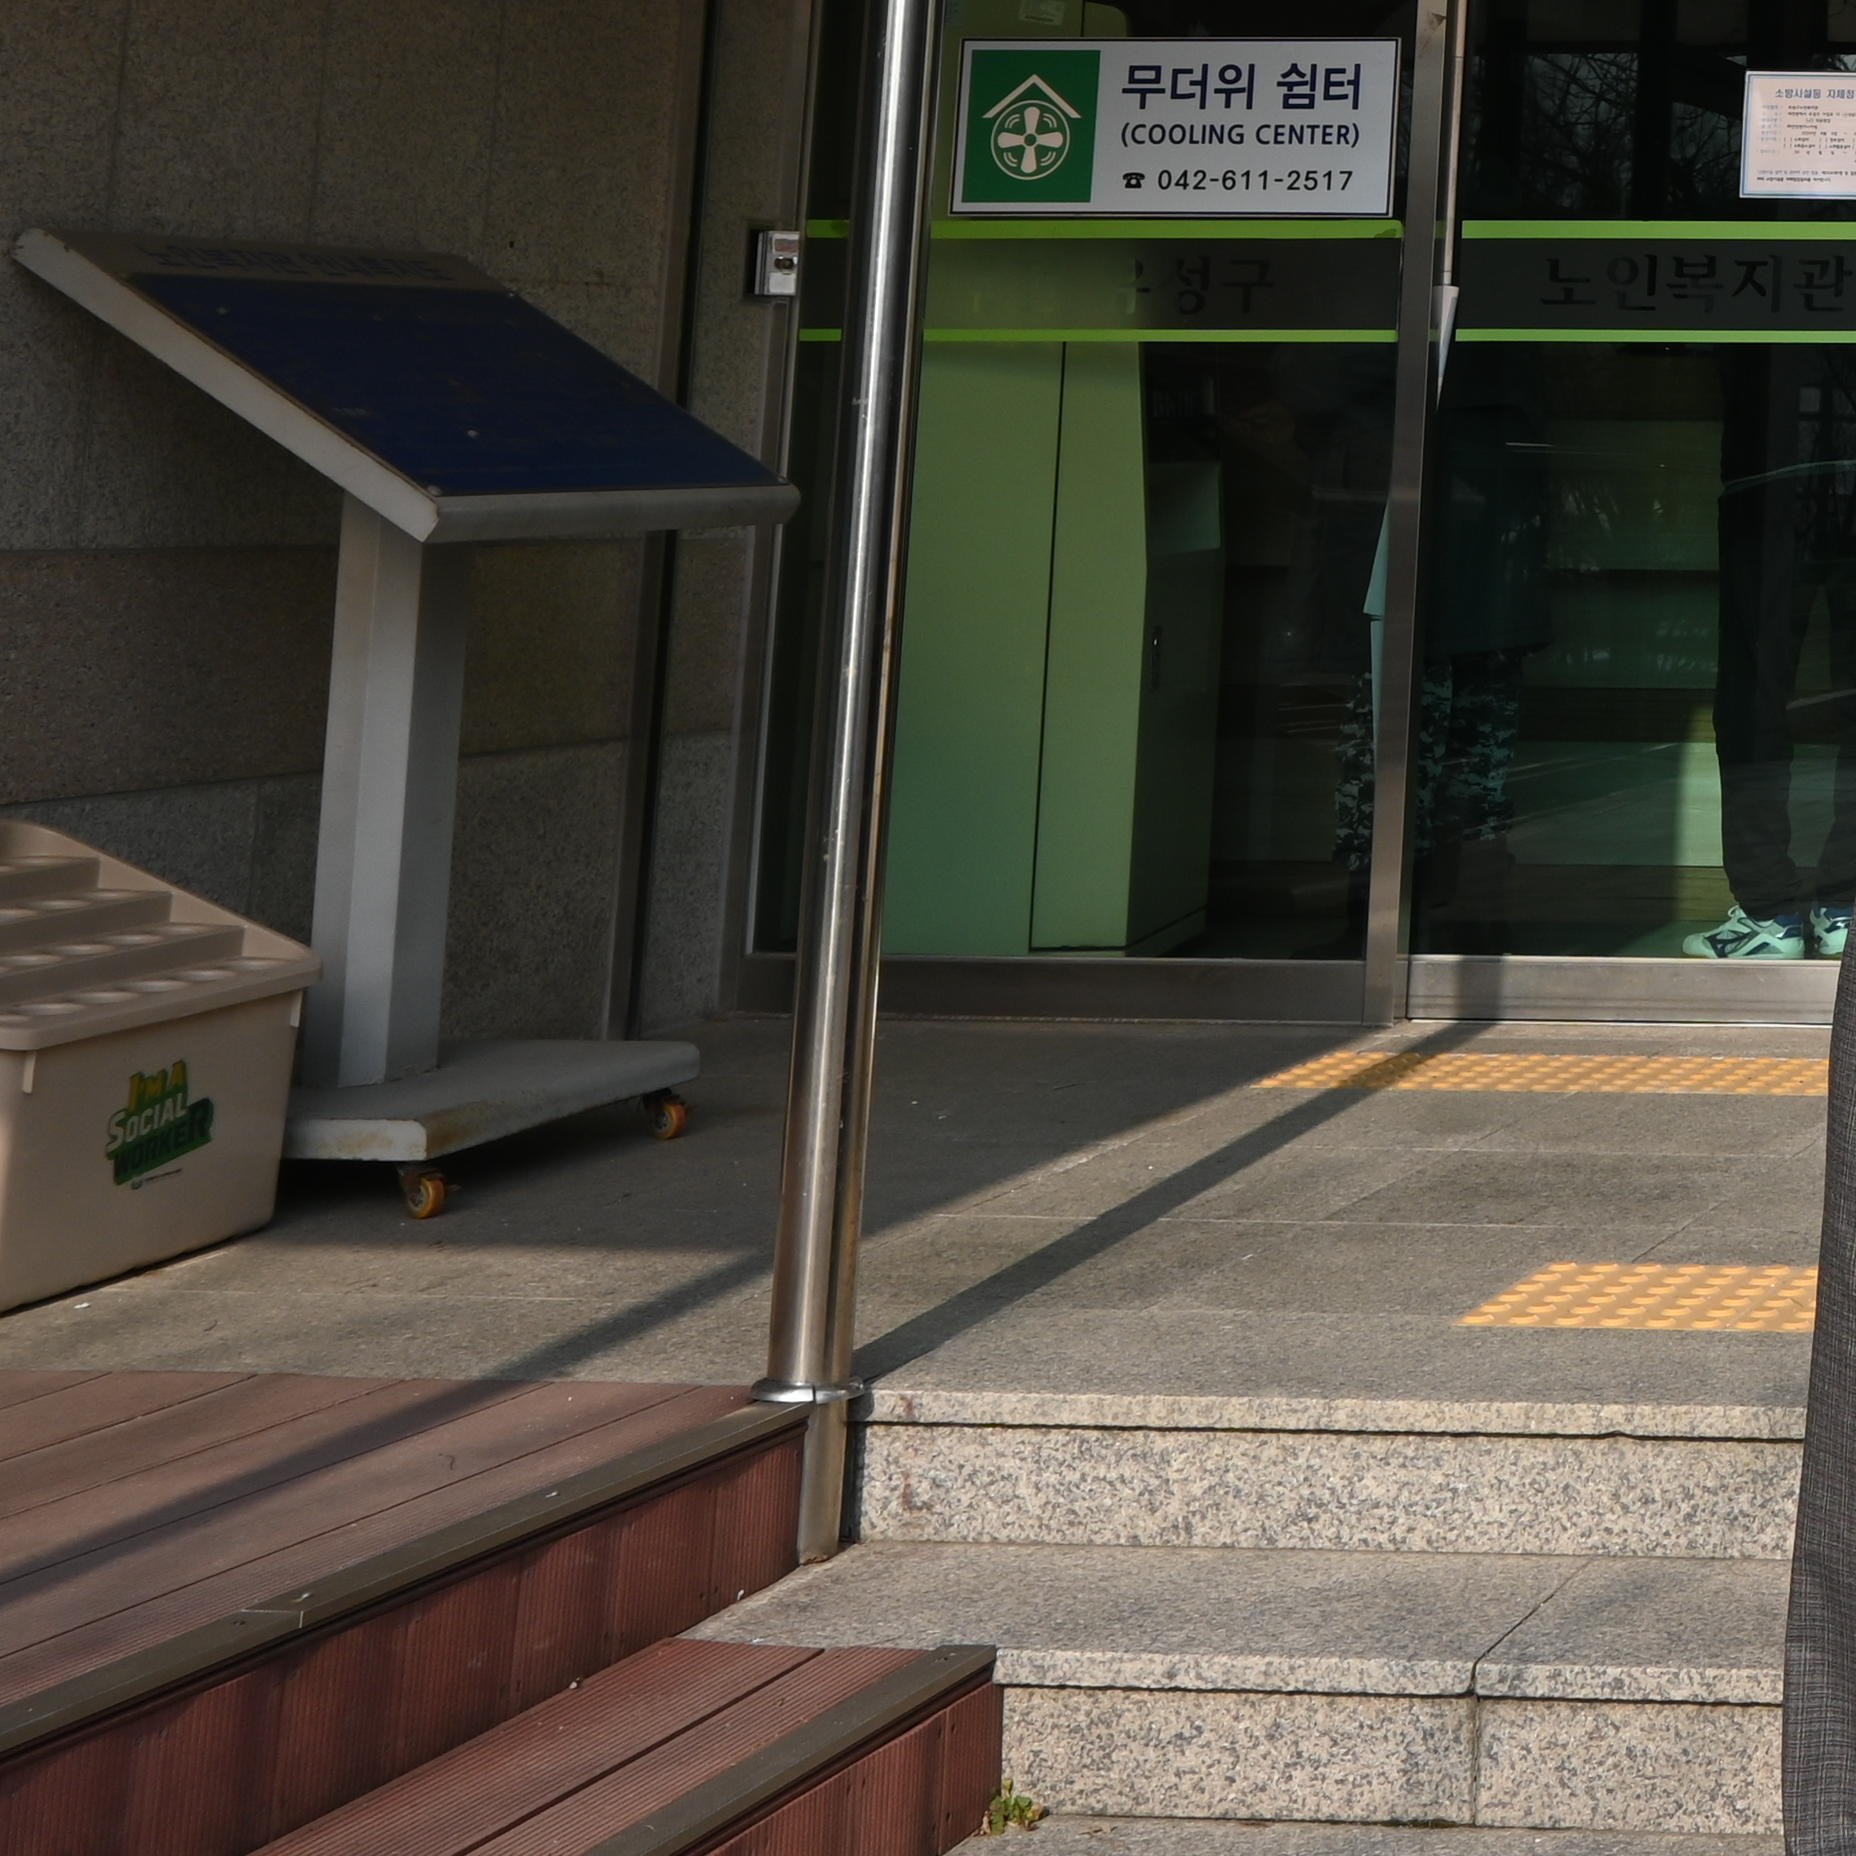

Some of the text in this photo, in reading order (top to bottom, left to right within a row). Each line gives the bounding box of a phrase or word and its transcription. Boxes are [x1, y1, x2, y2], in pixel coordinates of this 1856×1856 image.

[1121, 62, 1363, 112] 무더위 쉼터
[1120, 121, 1361, 149] (COOLING CENTER)
[1157, 168, 1354, 192] 042-611-2517
[106, 1092, 189, 1153] SOCIAL
